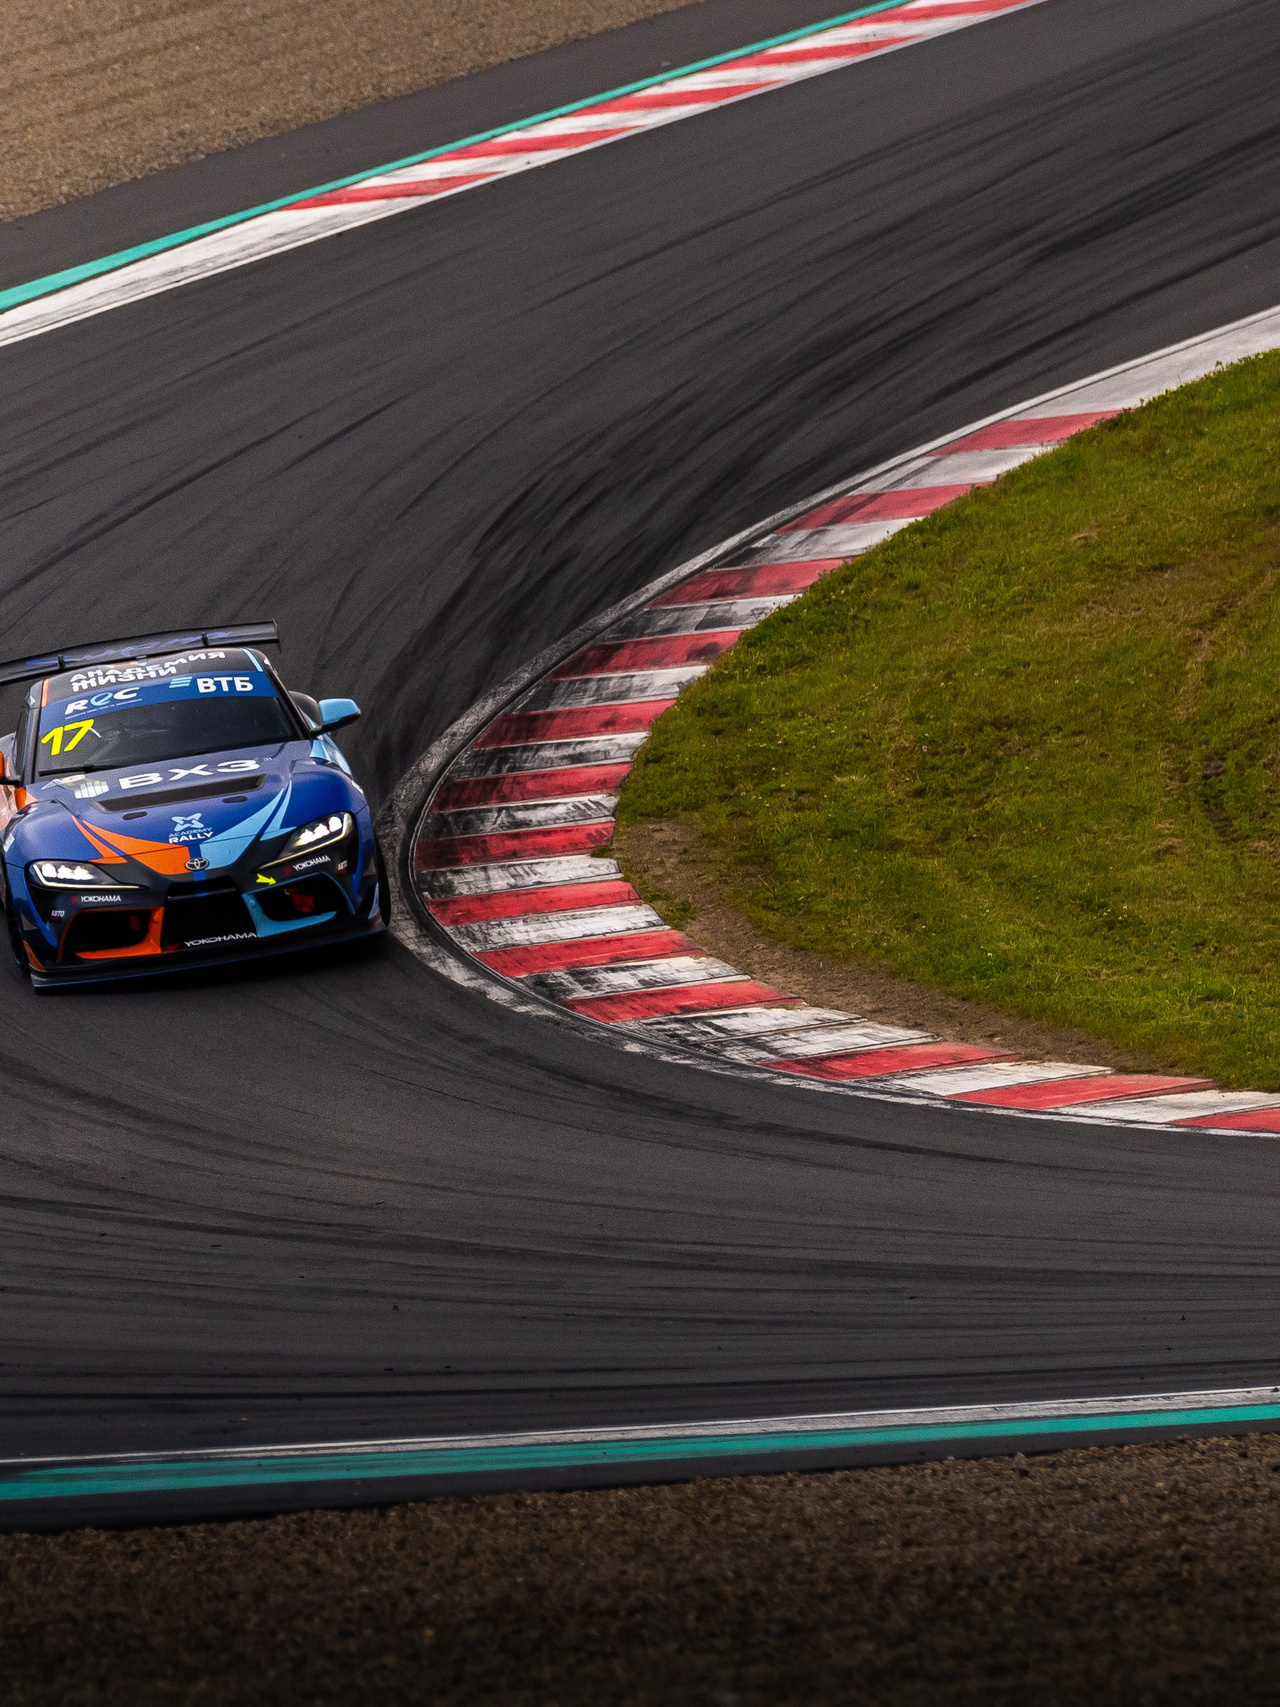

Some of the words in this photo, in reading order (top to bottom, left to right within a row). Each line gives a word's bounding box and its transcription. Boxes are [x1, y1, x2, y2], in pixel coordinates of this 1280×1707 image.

[196, 677, 253, 693] ВТБ
[40, 718, 95, 756] 17
[119, 759, 260, 790] BX3
[169, 827, 212, 838] ACADEMY
[169, 831, 214, 844] RALLY
[293, 855, 331, 871] YOKOHAMA
[80, 895, 122, 903] YOKOHAMA
[184, 932, 258, 947] YOKOHAMA
